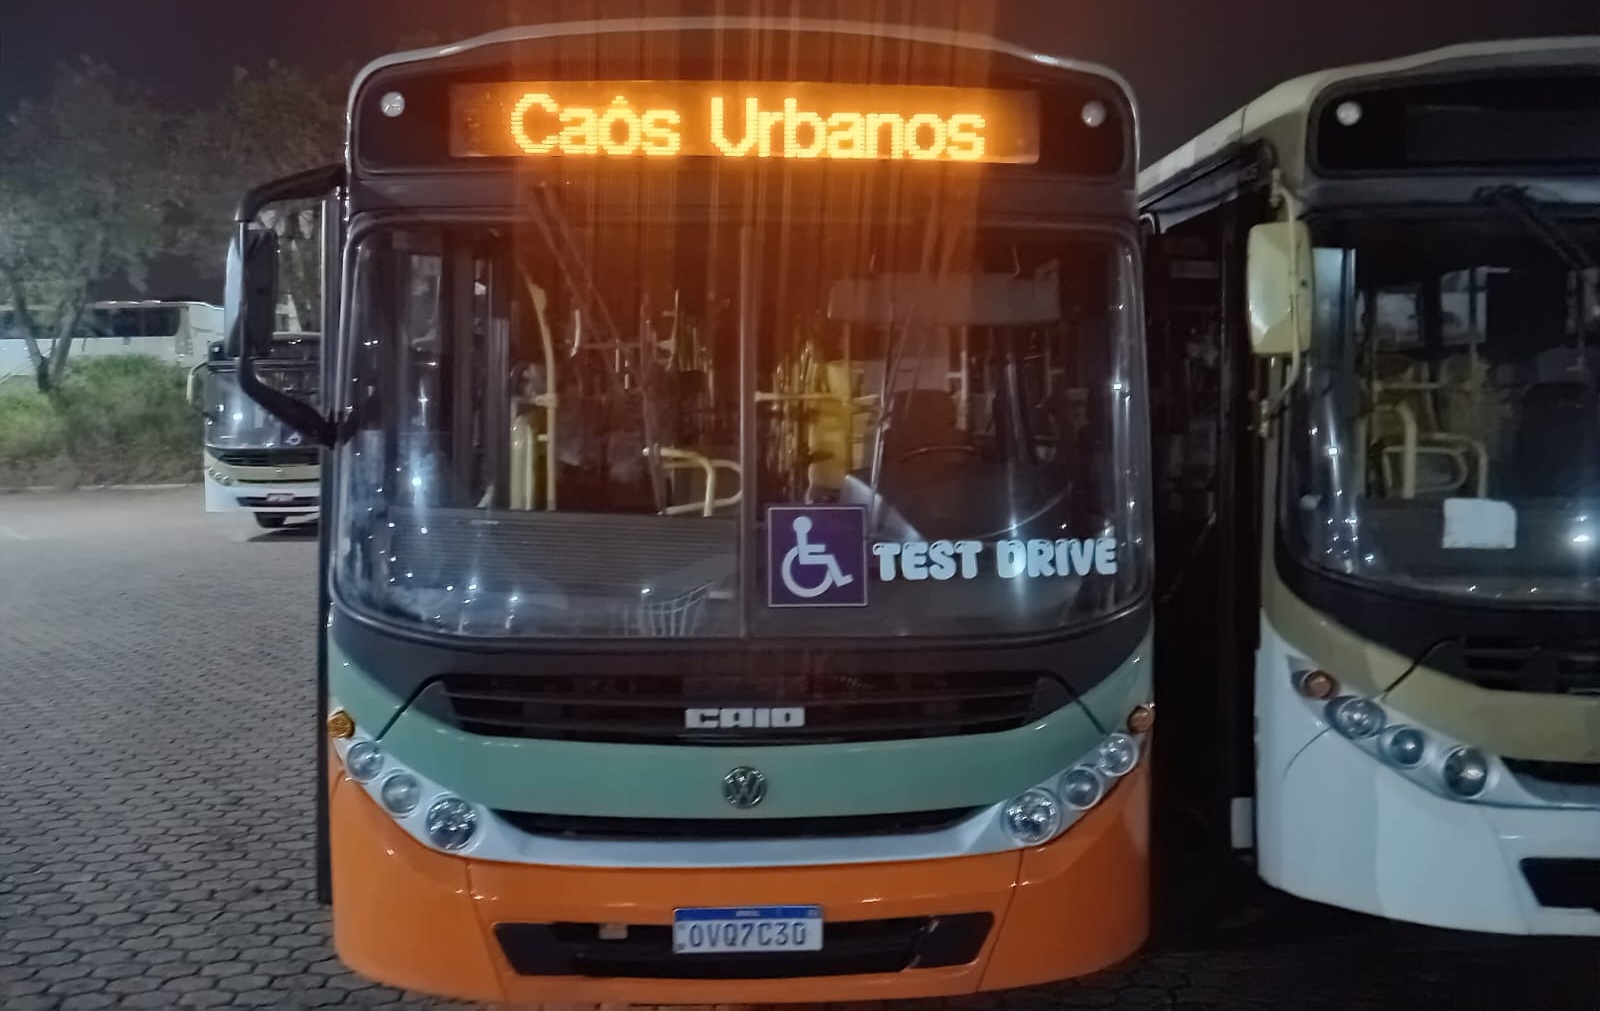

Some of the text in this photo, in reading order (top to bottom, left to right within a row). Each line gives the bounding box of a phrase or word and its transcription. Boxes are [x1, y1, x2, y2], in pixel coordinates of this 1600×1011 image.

[511, 93, 986, 160] Caôs Urbanos
[872, 538, 1118, 581] TEST DRIVE
[685, 708, 805, 728] CAIO
